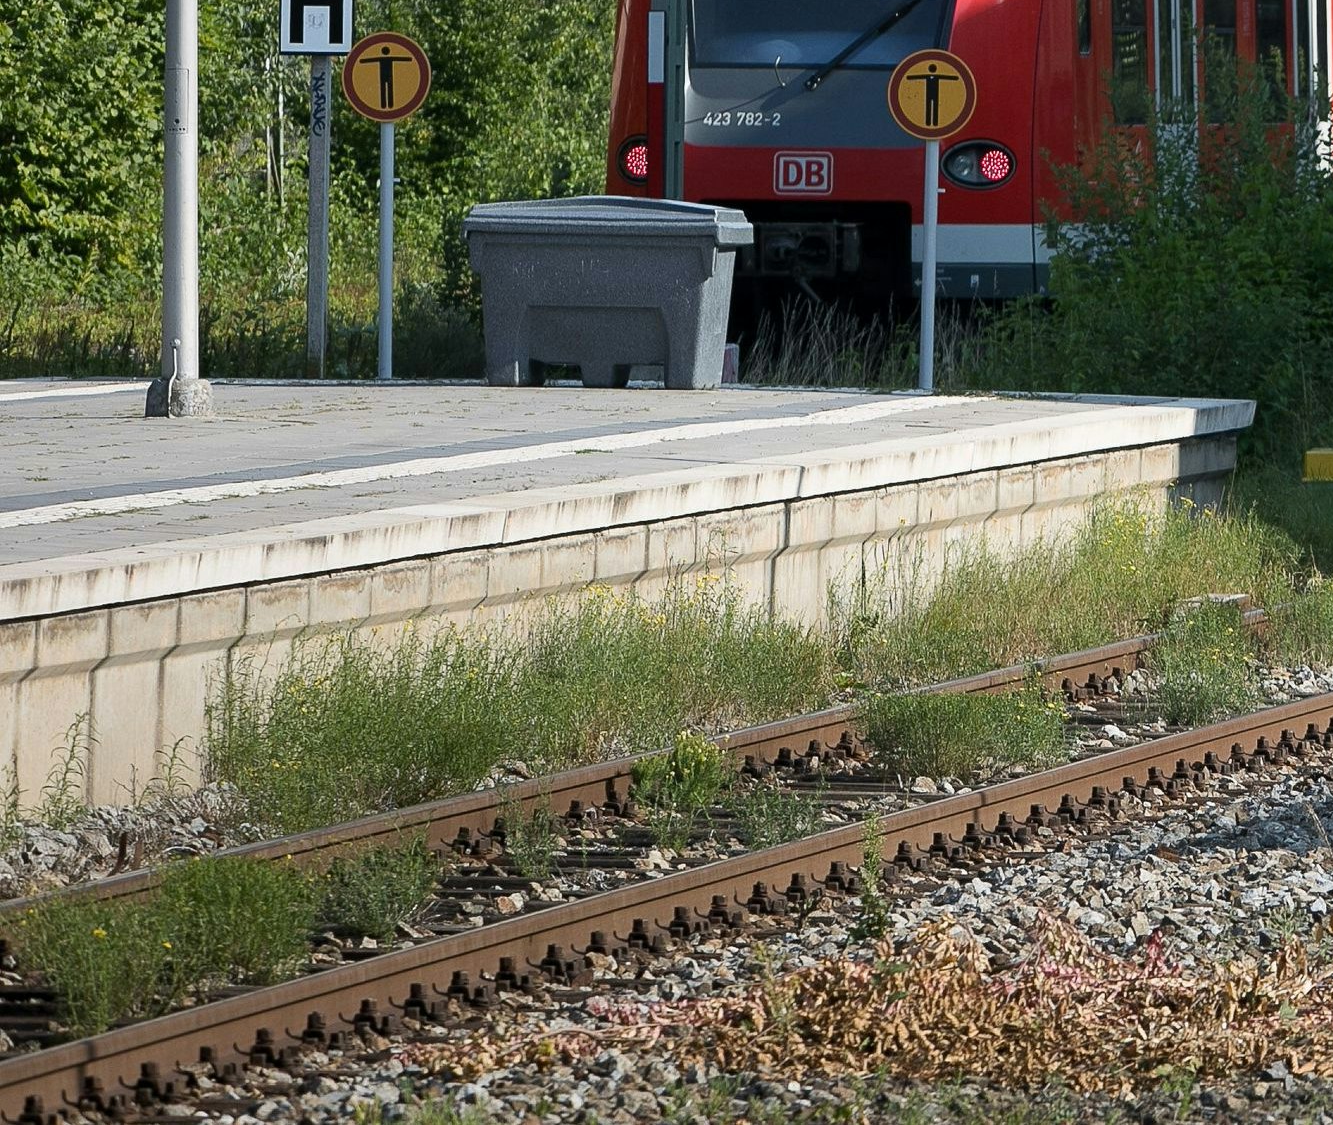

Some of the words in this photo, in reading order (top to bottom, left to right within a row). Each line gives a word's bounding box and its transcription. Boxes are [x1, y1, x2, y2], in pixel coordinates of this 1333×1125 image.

[703, 111, 731, 126] 423
[736, 111, 781, 126] 782-2
[782, 159, 825, 187] DB
